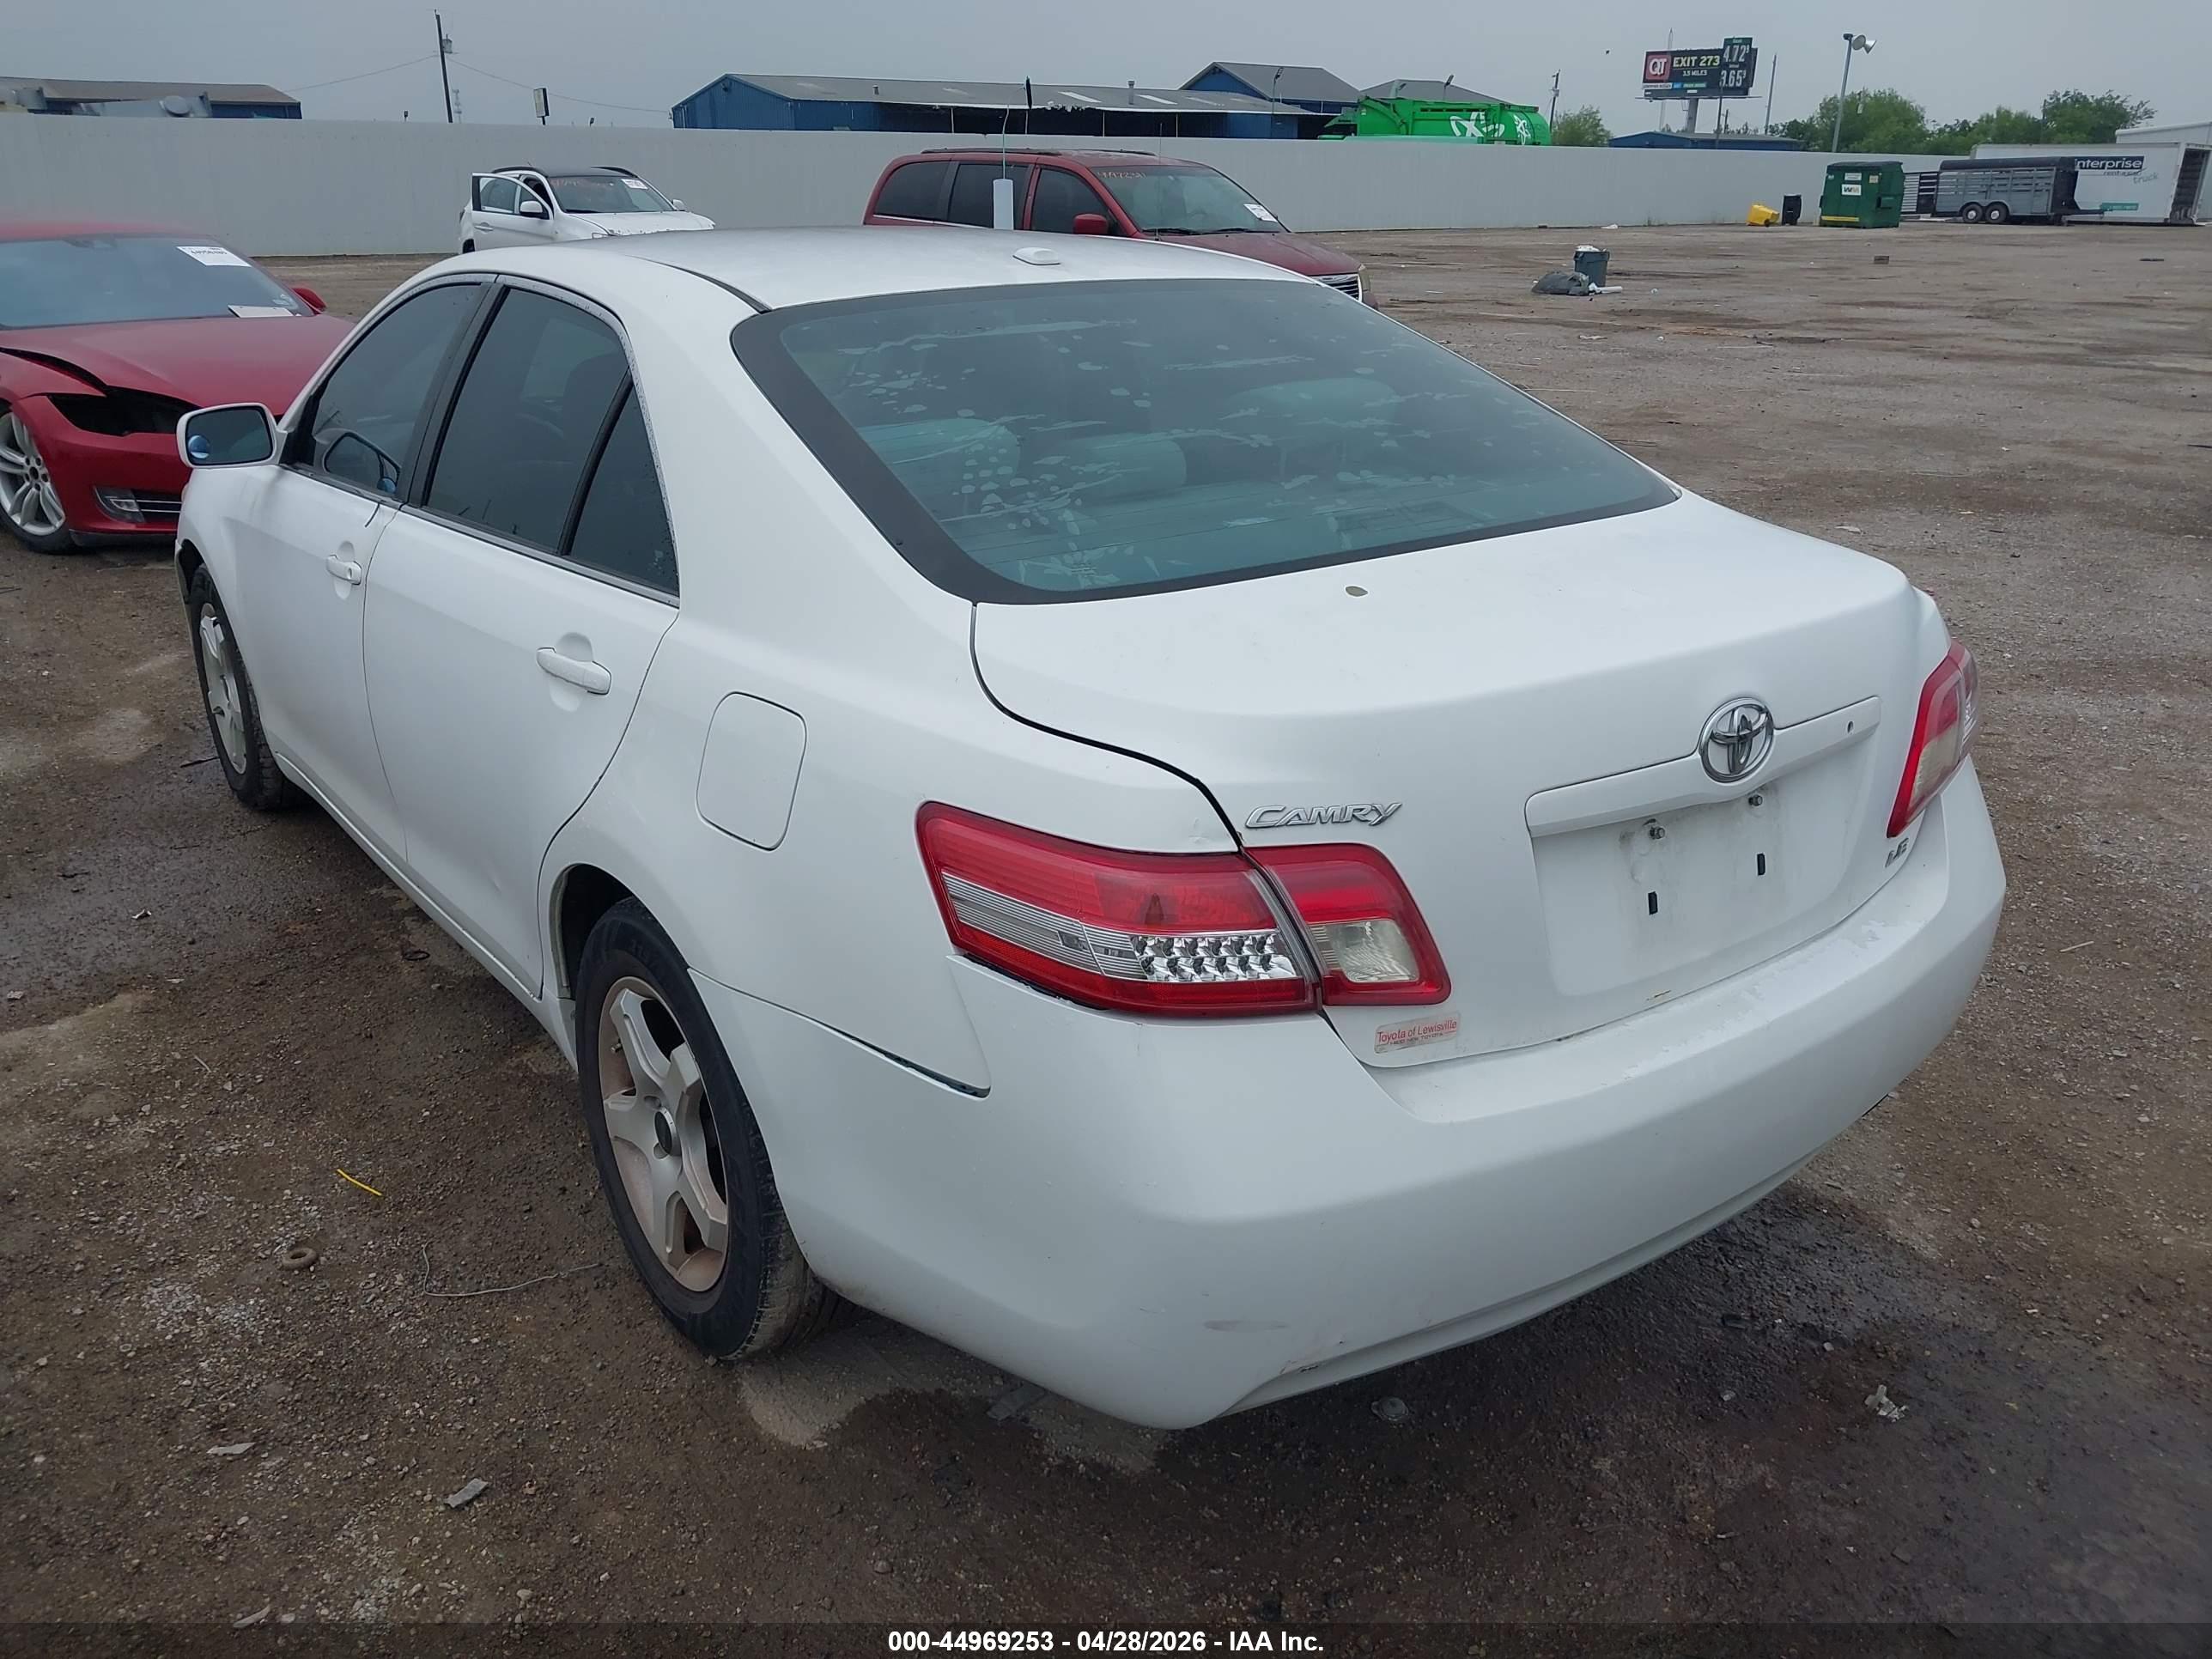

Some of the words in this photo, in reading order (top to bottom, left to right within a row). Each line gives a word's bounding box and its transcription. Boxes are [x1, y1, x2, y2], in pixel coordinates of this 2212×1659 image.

[1649, 58, 1668, 76] QT
[1673, 56, 1698, 68] EXIT
[1699, 55, 1720, 67] 273
[2075, 158, 2142, 170] nterprise
[1245, 802, 1402, 829] CAMRY
[1376, 1029, 1407, 1044] Toyota
[1407, 1026, 1417, 1036] of
[1417, 1019, 1457, 1036] Lewisville
